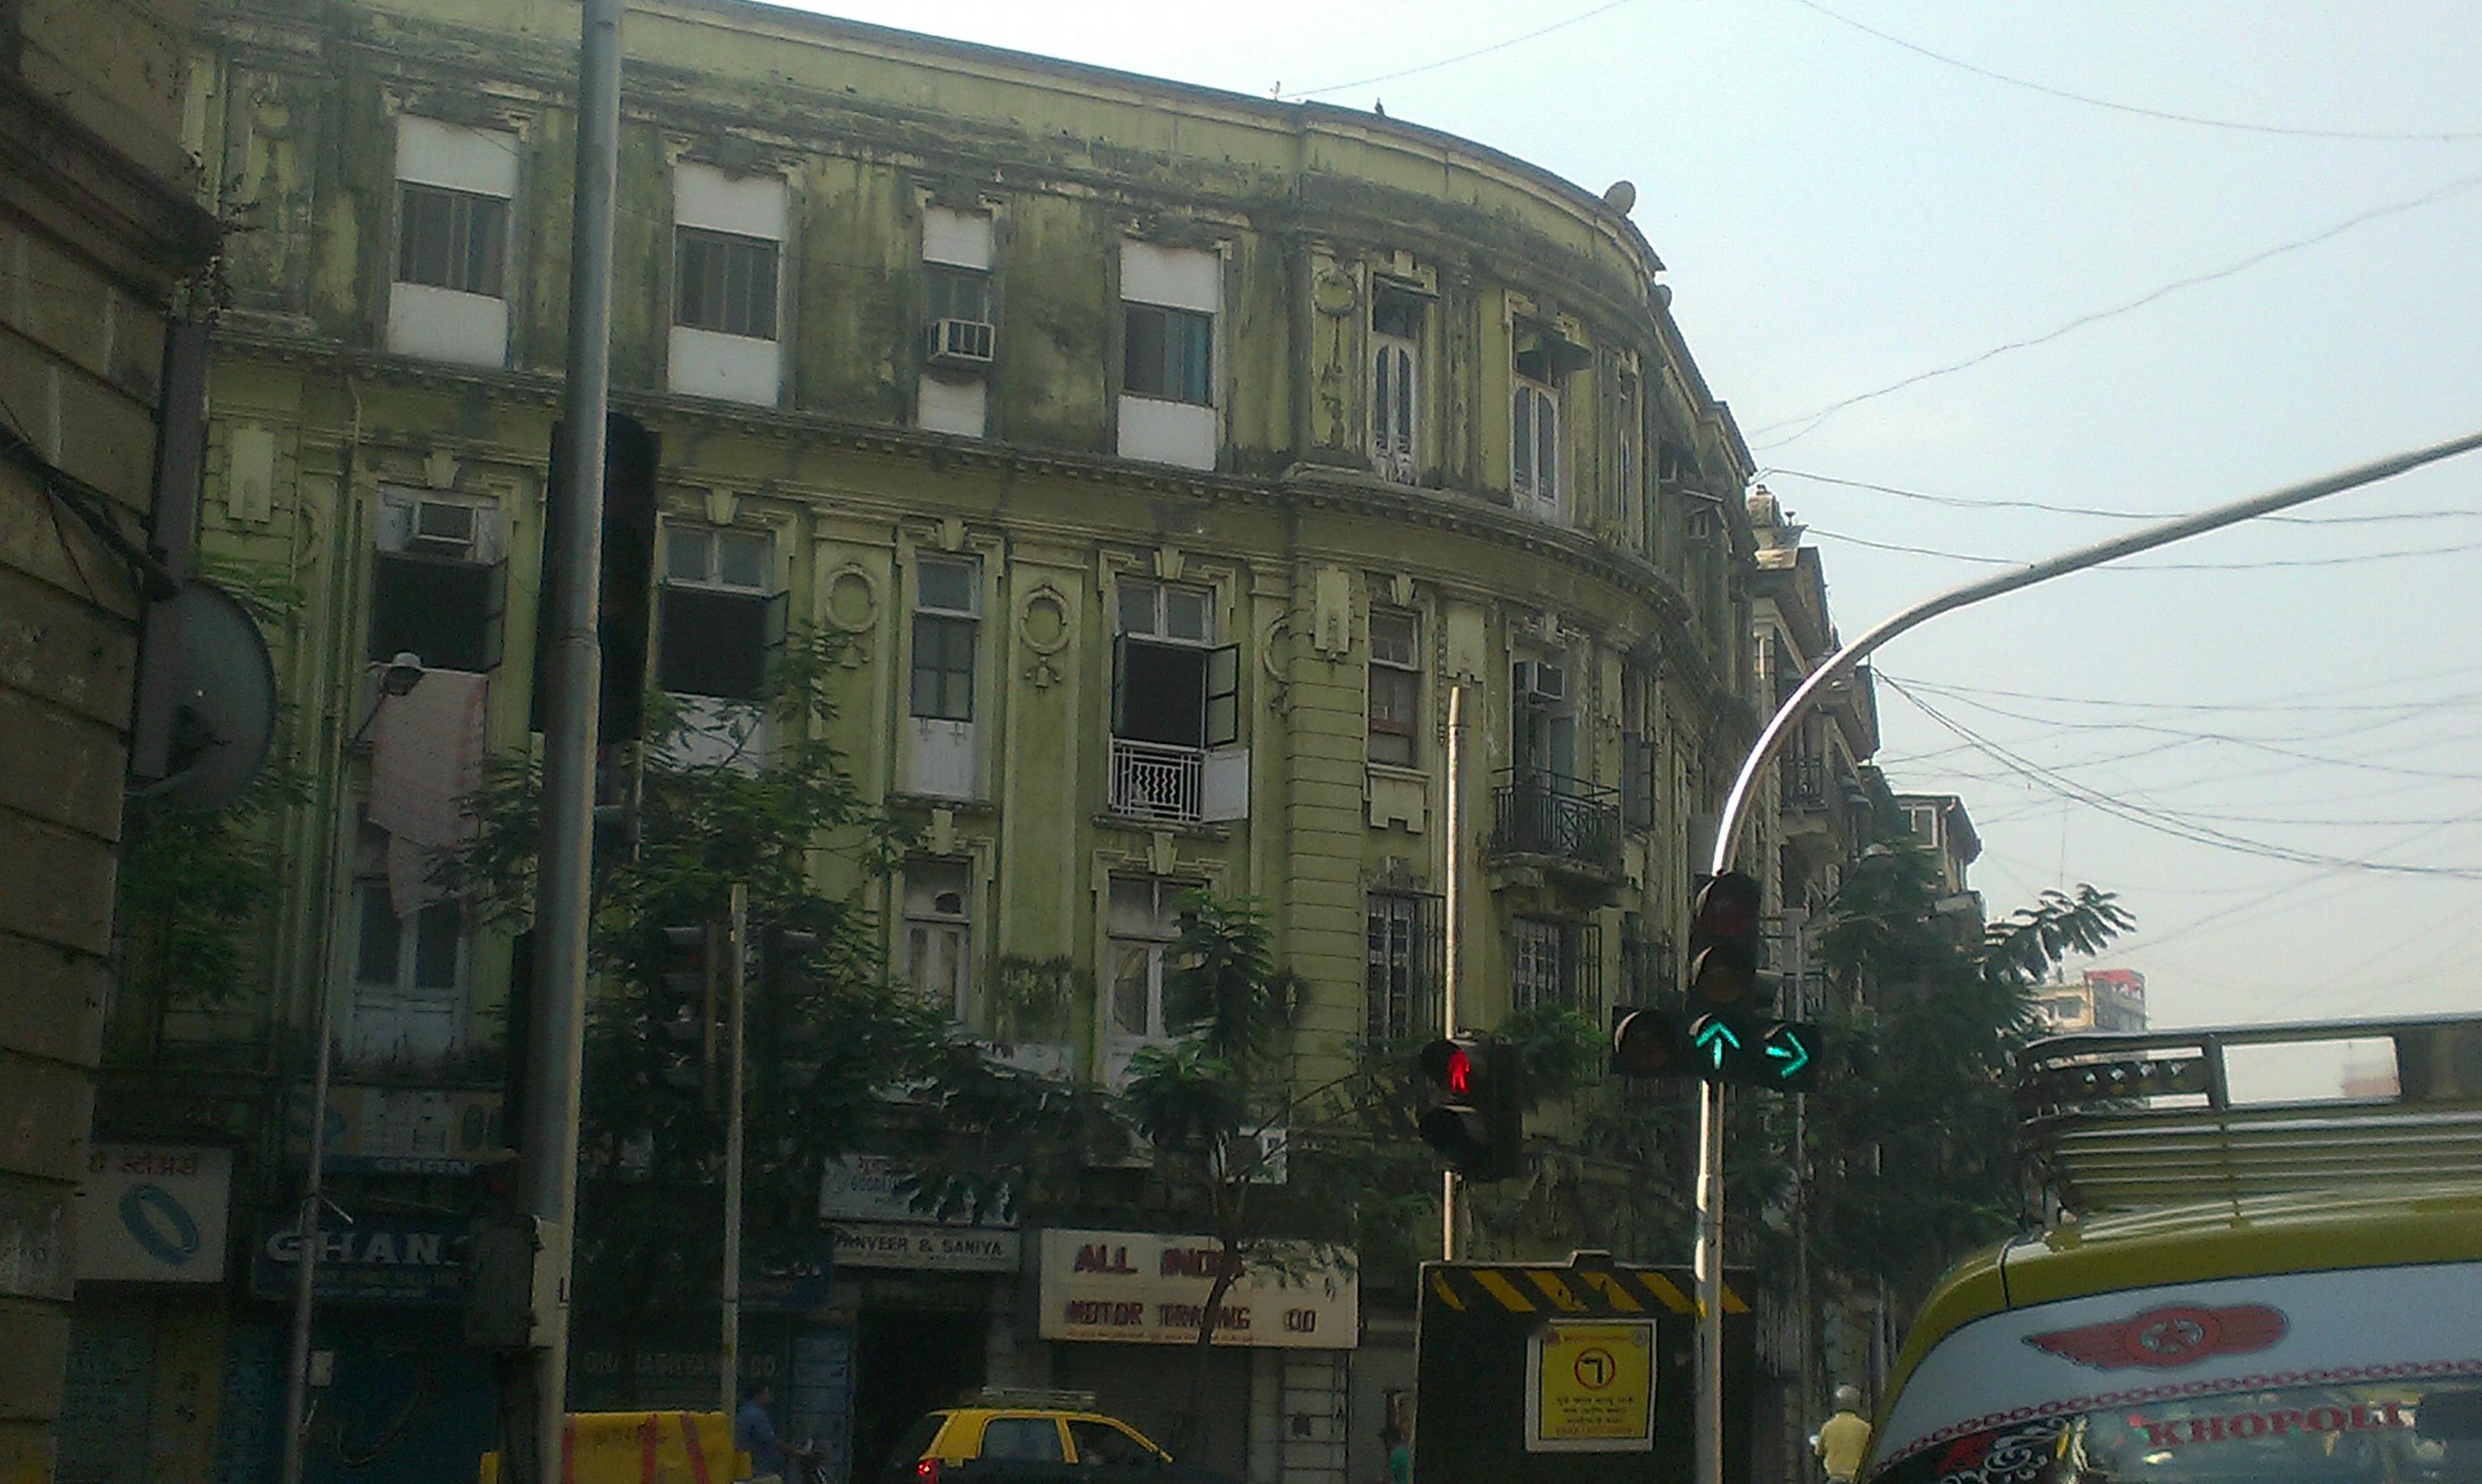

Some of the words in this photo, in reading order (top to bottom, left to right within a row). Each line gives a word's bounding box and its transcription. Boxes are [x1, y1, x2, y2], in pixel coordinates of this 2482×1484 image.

[1074, 1243, 1138, 1274] ALL
[1160, 1247, 1246, 1278] INDA
[1065, 1299, 1144, 1326] MOTOR
[1157, 1303, 1252, 1330] TRAING
[2145, 1401, 2403, 1448] KHOPOLI
